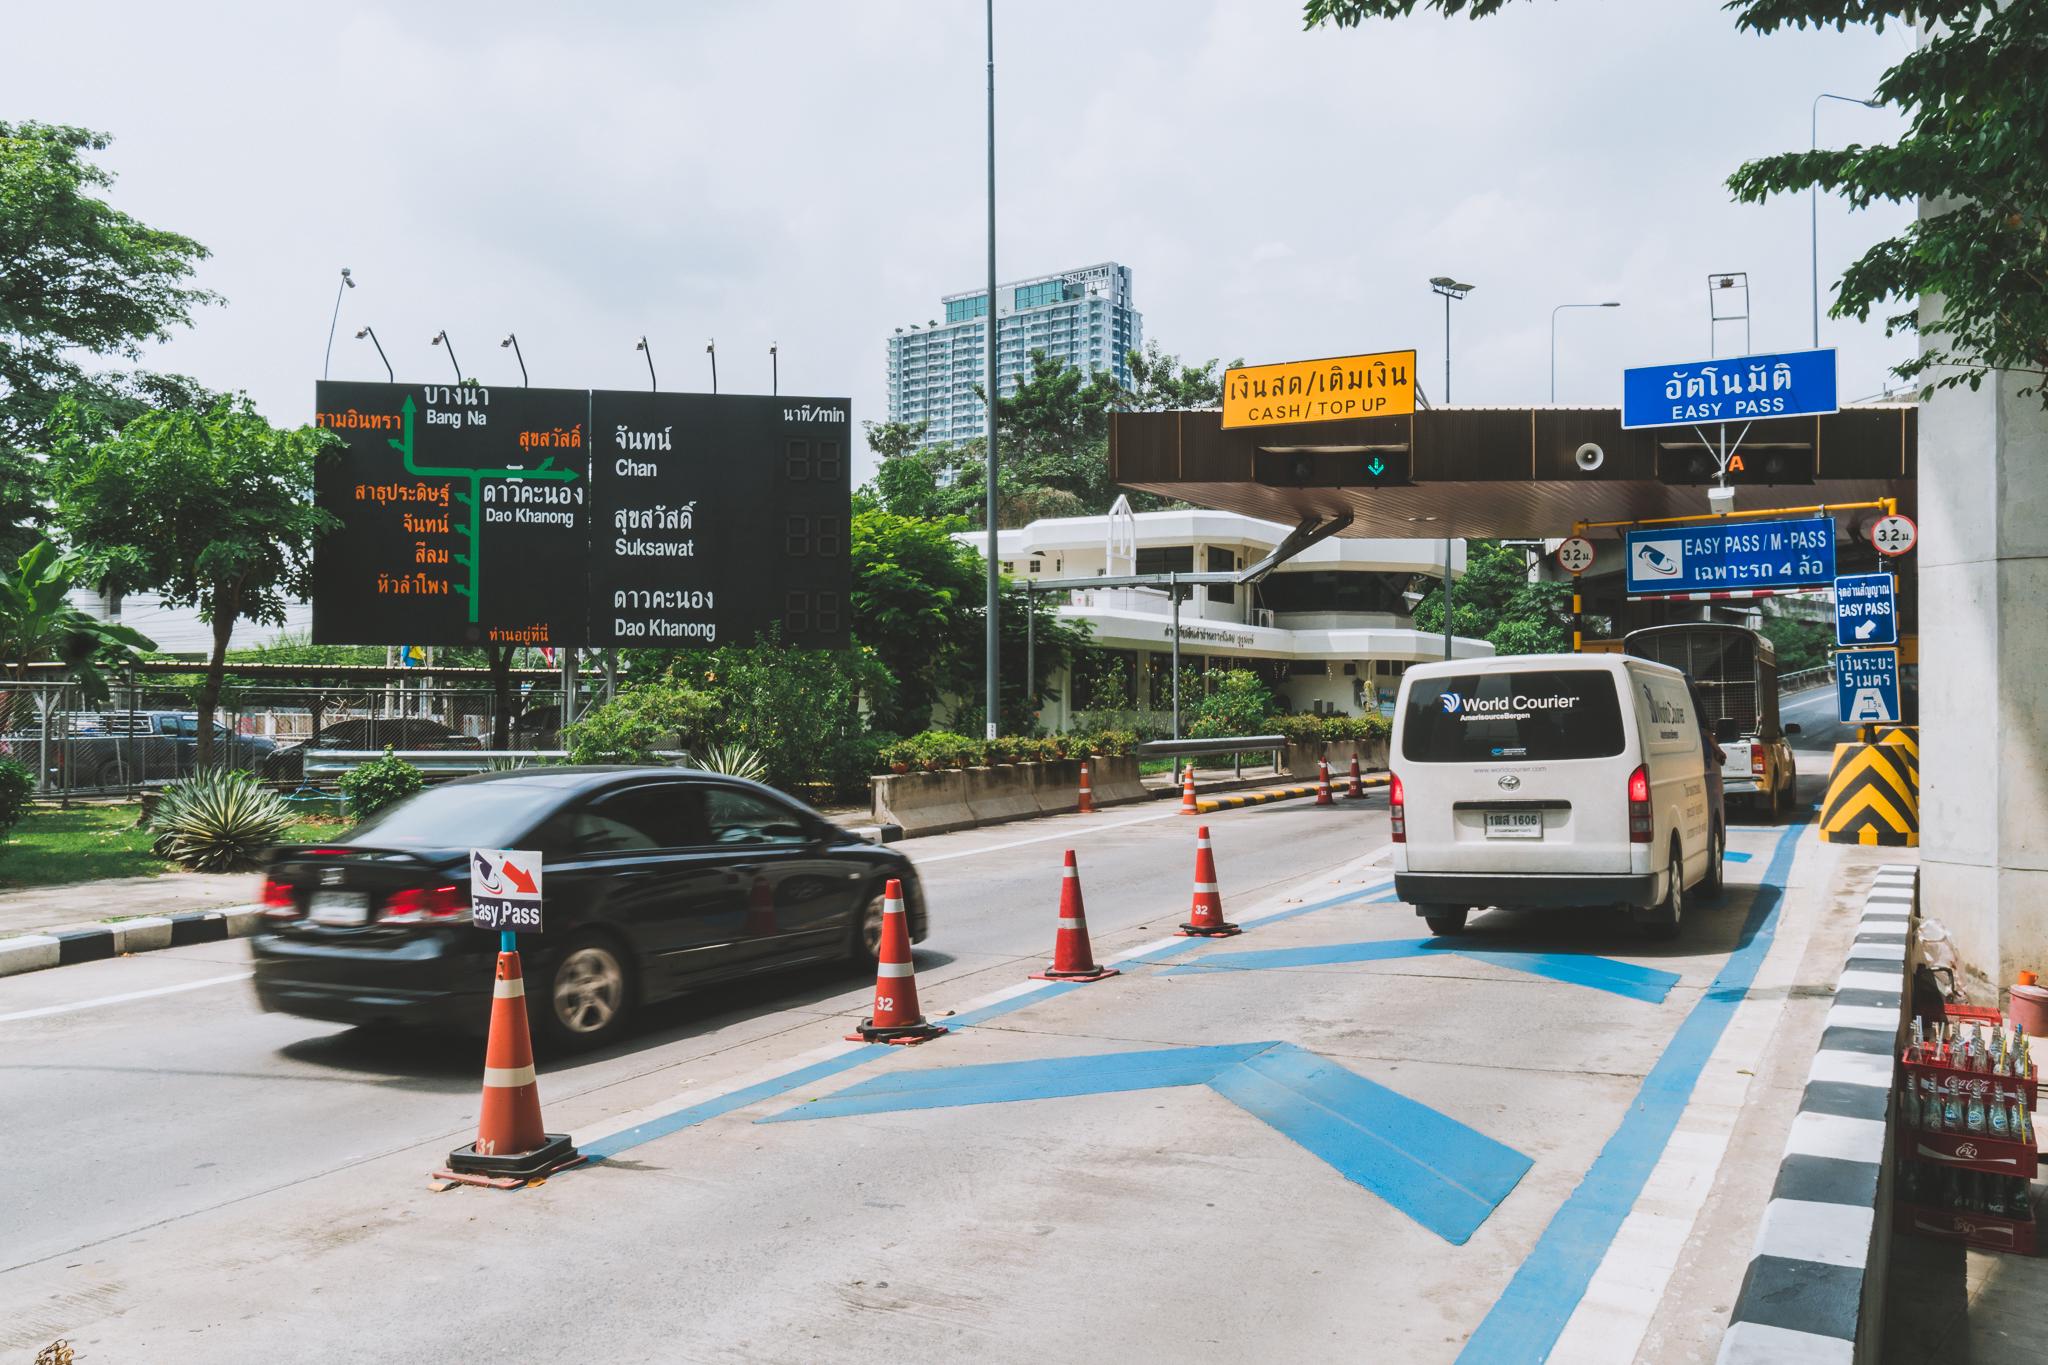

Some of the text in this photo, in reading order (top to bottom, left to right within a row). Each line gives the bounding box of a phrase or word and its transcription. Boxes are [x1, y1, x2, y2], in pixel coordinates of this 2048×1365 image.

[1231, 361, 1407, 401] เงินสด/เติมเงิน
[1665, 362, 1792, 400] อัตโนมัติ
[424, 385, 489, 406] บางนา
[1362, 397, 1387, 412] UP
[784, 404, 845, 423] นาที/min
[1672, 397, 1784, 420] EASY PASS
[316, 408, 401, 430] รามอินทรา
[426, 409, 487, 429] Bang Na
[519, 423, 581, 453] สุขสวัสดิ์
[615, 425, 672, 451] จันทน์
[615, 458, 657, 477] Chan
[355, 482, 449, 507] สาธุประดิษฐ์
[483, 484, 583, 504] ดาวคะนอง
[403, 513, 449, 533] จันทน์
[486, 508, 574, 528] Dao Khanong
[615, 501, 697, 535] สุขสวัสดิ์
[415, 541, 449, 564] สีลม
[615, 538, 694, 557] Suksawat
[1685, 537, 1720, 556] EASY
[1725, 535, 1760, 553] PASS
[1695, 554, 1823, 581] เฉพาะรถ 4 ล้อ
[377, 573, 448, 594] หัวลำโพง
[614, 590, 714, 609] ดาวคะนอง
[1839, 601, 1891, 617] EASY PASS
[615, 618, 716, 642] Dao Khanong
[1840, 654, 1894, 672] เว้นระยะ
[1462, 694, 1575, 712] World Courier
[1460, 712, 1531, 721] AmerisourceBergen
[1512, 815, 1537, 826] 1606
[473, 897, 541, 928] Easy Pass
[1195, 904, 1208, 915] 32
[877, 996, 894, 1012] 32
